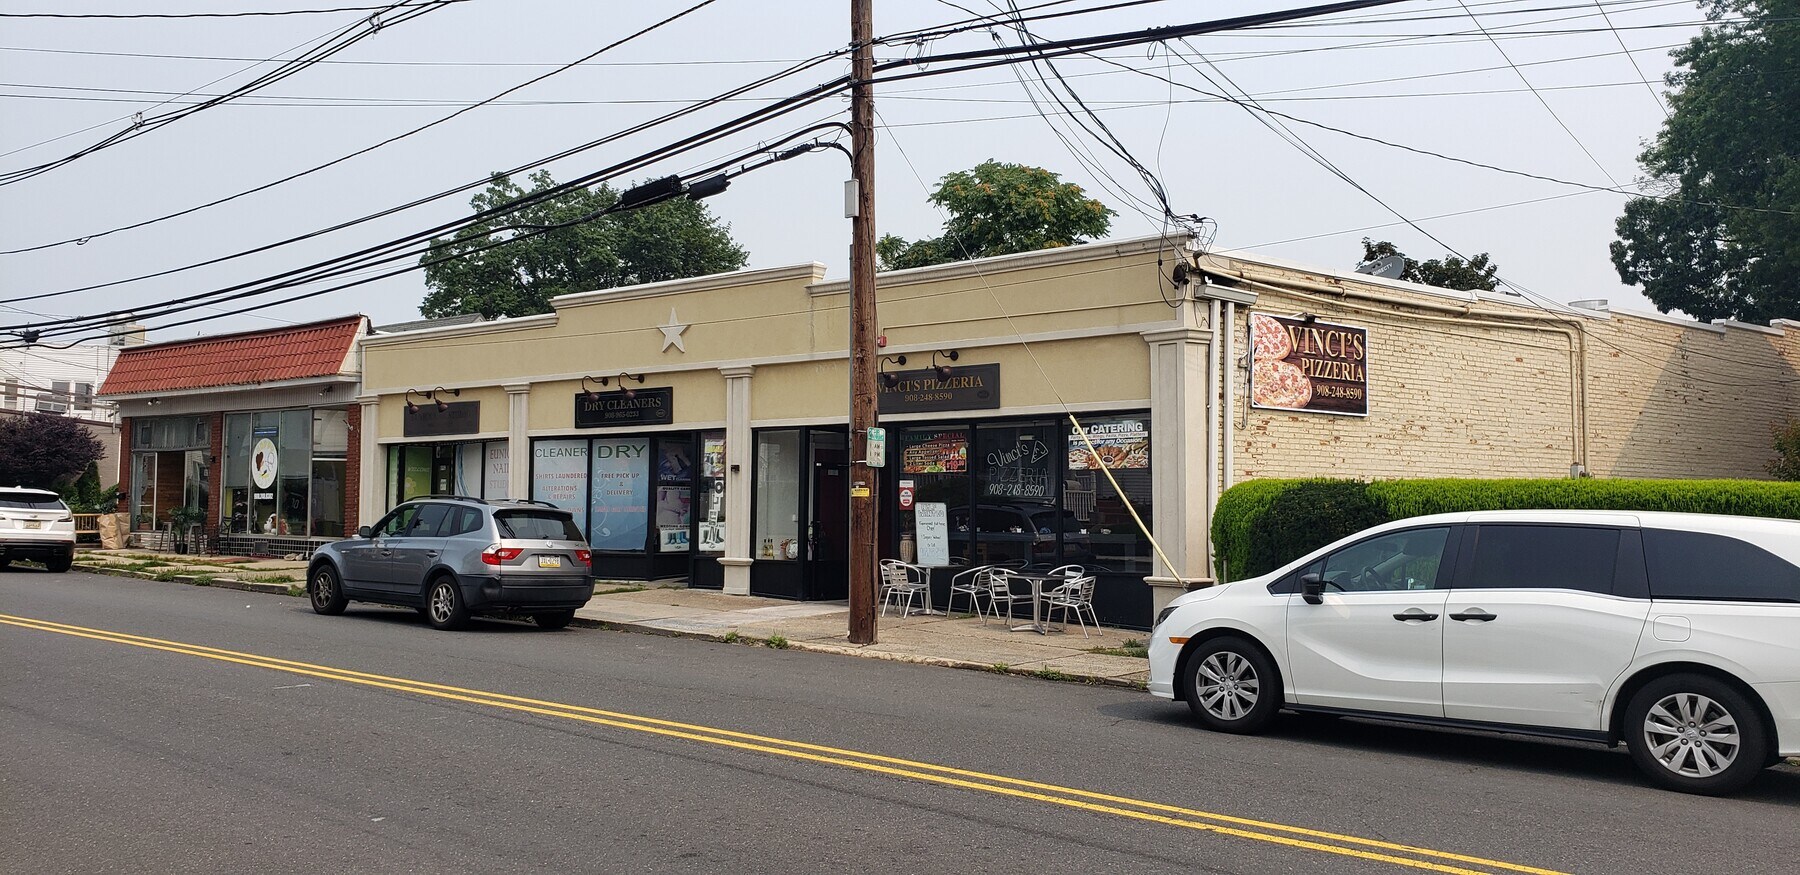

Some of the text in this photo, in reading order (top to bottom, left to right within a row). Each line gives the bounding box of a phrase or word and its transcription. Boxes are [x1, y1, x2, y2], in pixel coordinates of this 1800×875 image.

[1372, 262, 1393, 275] DIRECTV
[1287, 325, 1364, 360] VINCI'S
[1300, 358, 1365, 382] PIZZERIA
[923, 375, 983, 391] PIZZERIA
[904, 392, 953, 402] 908-248-8590
[1316, 384, 1362, 400] 908-248-8590
[584, 397, 662, 412] DRY CLEANERS
[1091, 422, 1143, 434] CATERING
[535, 447, 588, 458] CLEANER
[597, 444, 646, 459] DRY
[987, 441, 1029, 467] Vinci's
[660, 473, 677, 481] WET
[989, 466, 1048, 486] PIZZERIA
